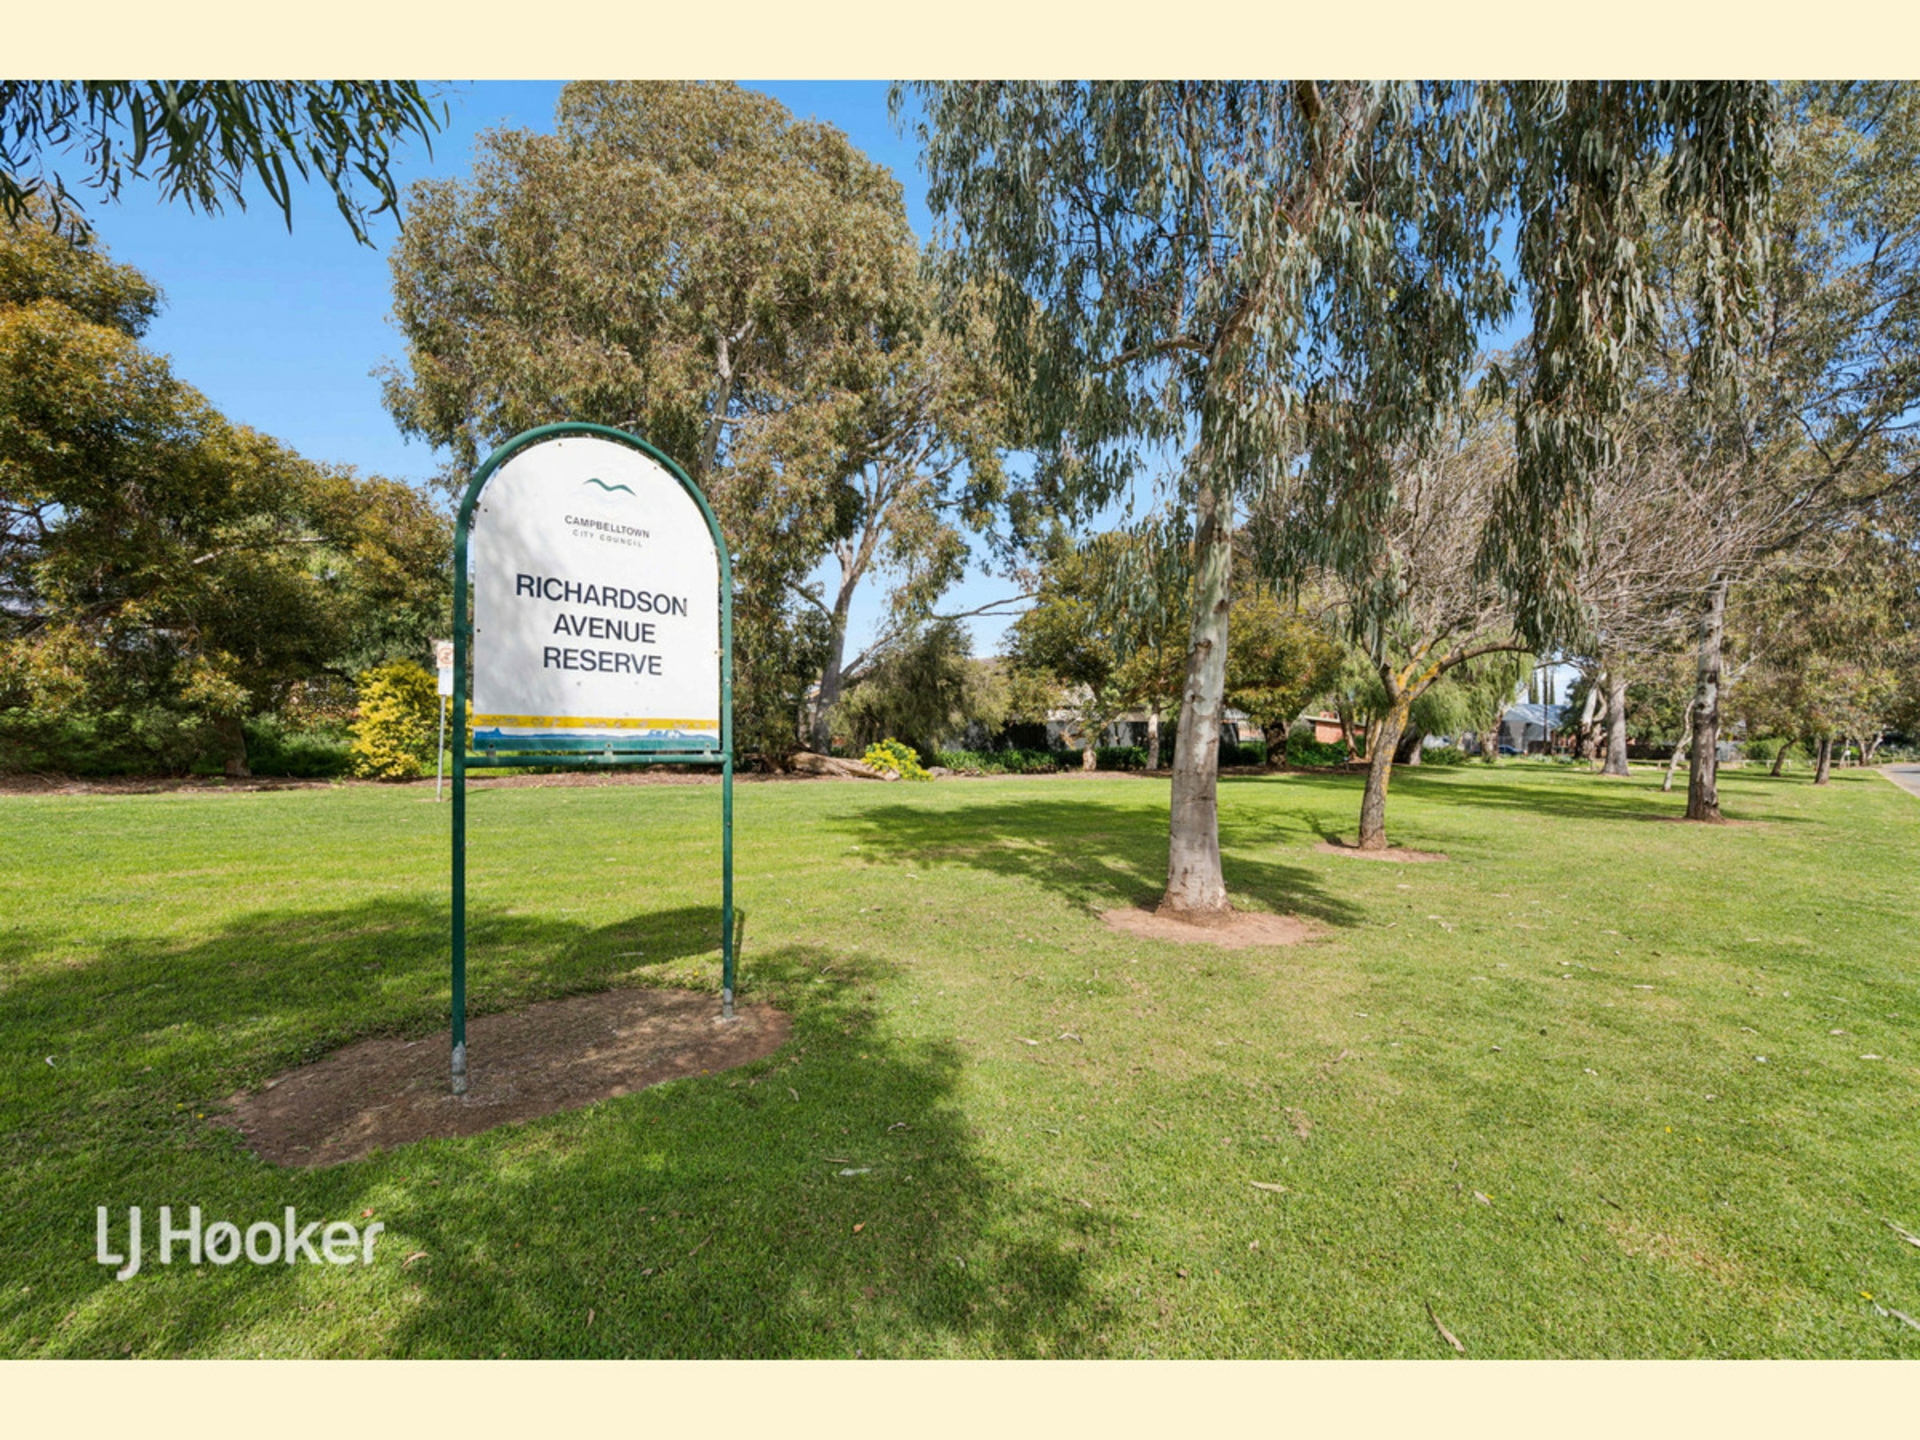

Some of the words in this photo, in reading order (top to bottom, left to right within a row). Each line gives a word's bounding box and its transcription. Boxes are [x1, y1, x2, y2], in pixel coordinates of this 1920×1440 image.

[564, 514, 650, 539] CAMPBELLTOWN
[572, 529, 595, 540] CITY
[599, 533, 643, 548] COUNCIL
[516, 573, 688, 617] RICHARDSON
[552, 613, 656, 644] AVENUE
[543, 646, 663, 676] RESERVE
